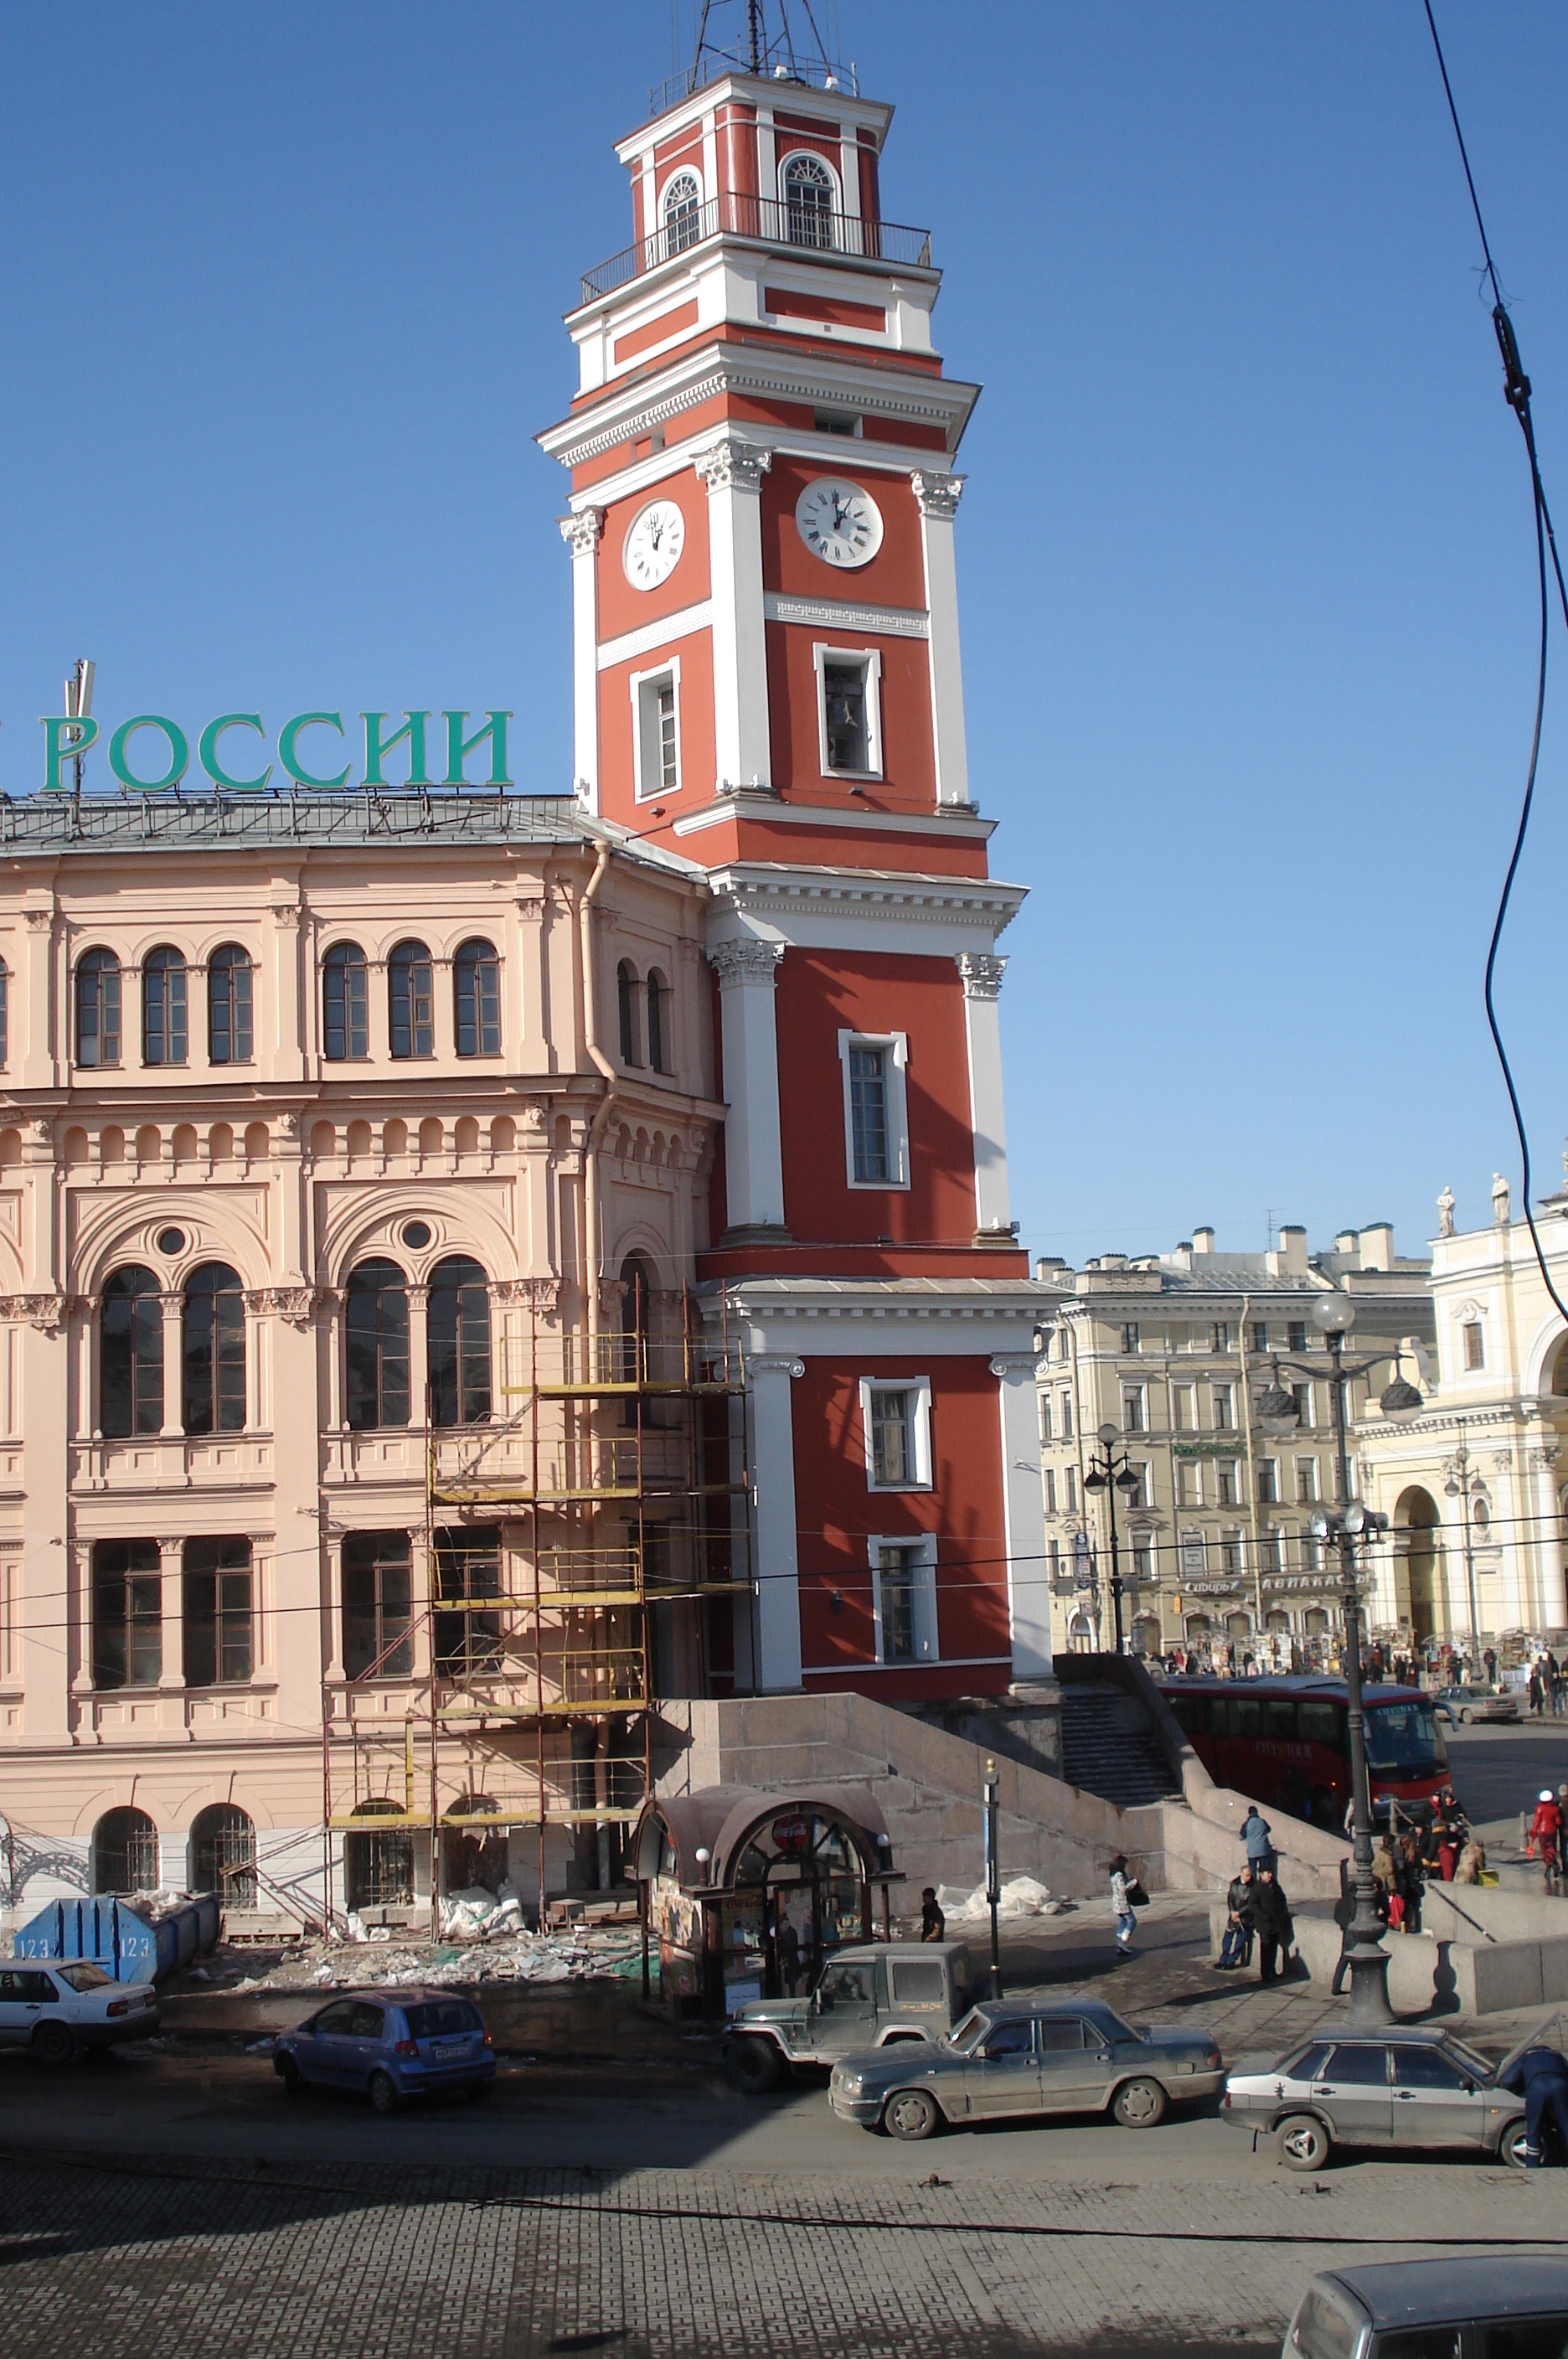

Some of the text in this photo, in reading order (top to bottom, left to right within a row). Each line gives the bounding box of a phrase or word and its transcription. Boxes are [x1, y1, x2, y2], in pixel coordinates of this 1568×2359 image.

[38, 710, 514, 794] РОССИИ
[1185, 1581, 1230, 1592] Сибирь
[1377, 1707, 1395, 1716] CITY
[1256, 1741, 1313, 1759] CITY TOUR
[20, 1939, 49, 1959] 123
[121, 1937, 149, 1958] 123
